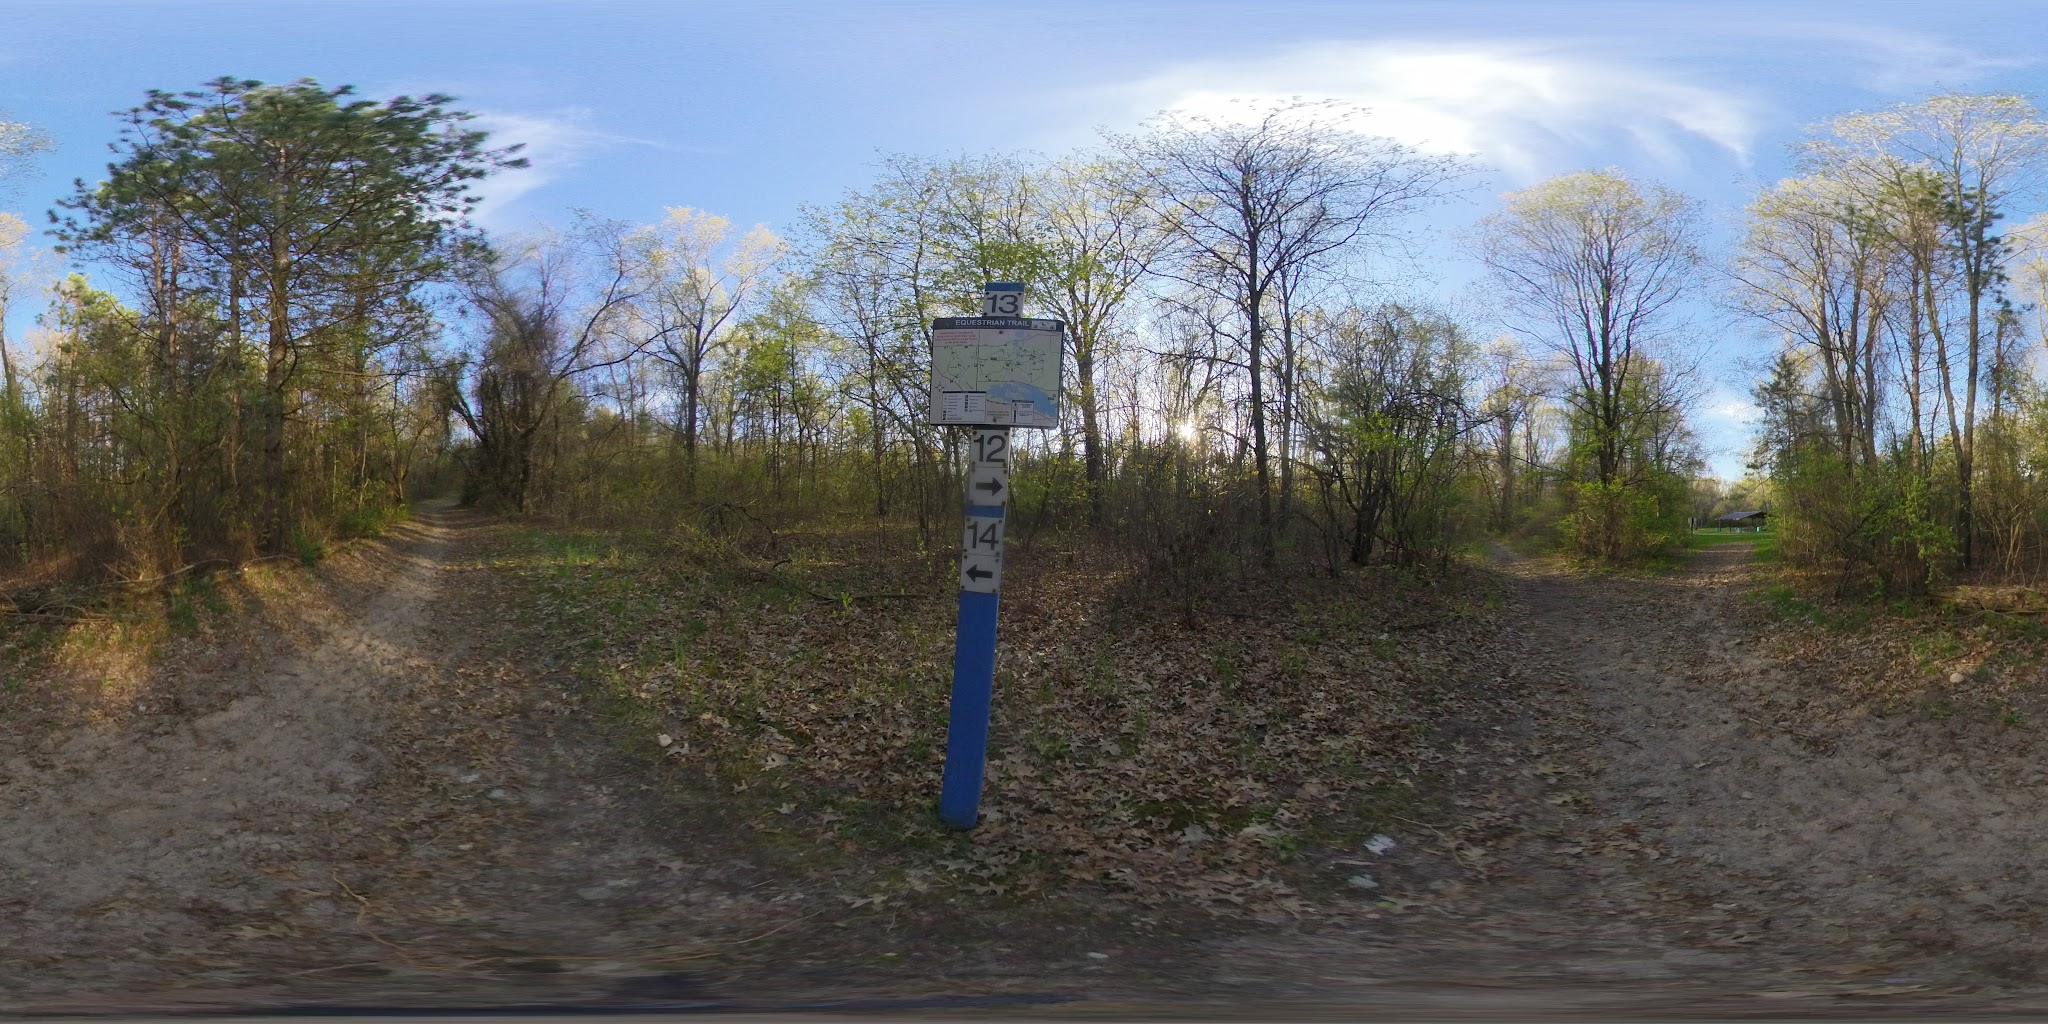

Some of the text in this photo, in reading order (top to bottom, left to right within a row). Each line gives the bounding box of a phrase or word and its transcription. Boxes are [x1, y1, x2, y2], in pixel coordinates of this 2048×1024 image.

[986, 294, 1019, 314] 13
[1007, 319, 1029, 327] TRAIL
[973, 434, 1007, 463] 12
[967, 521, 999, 550] 14
